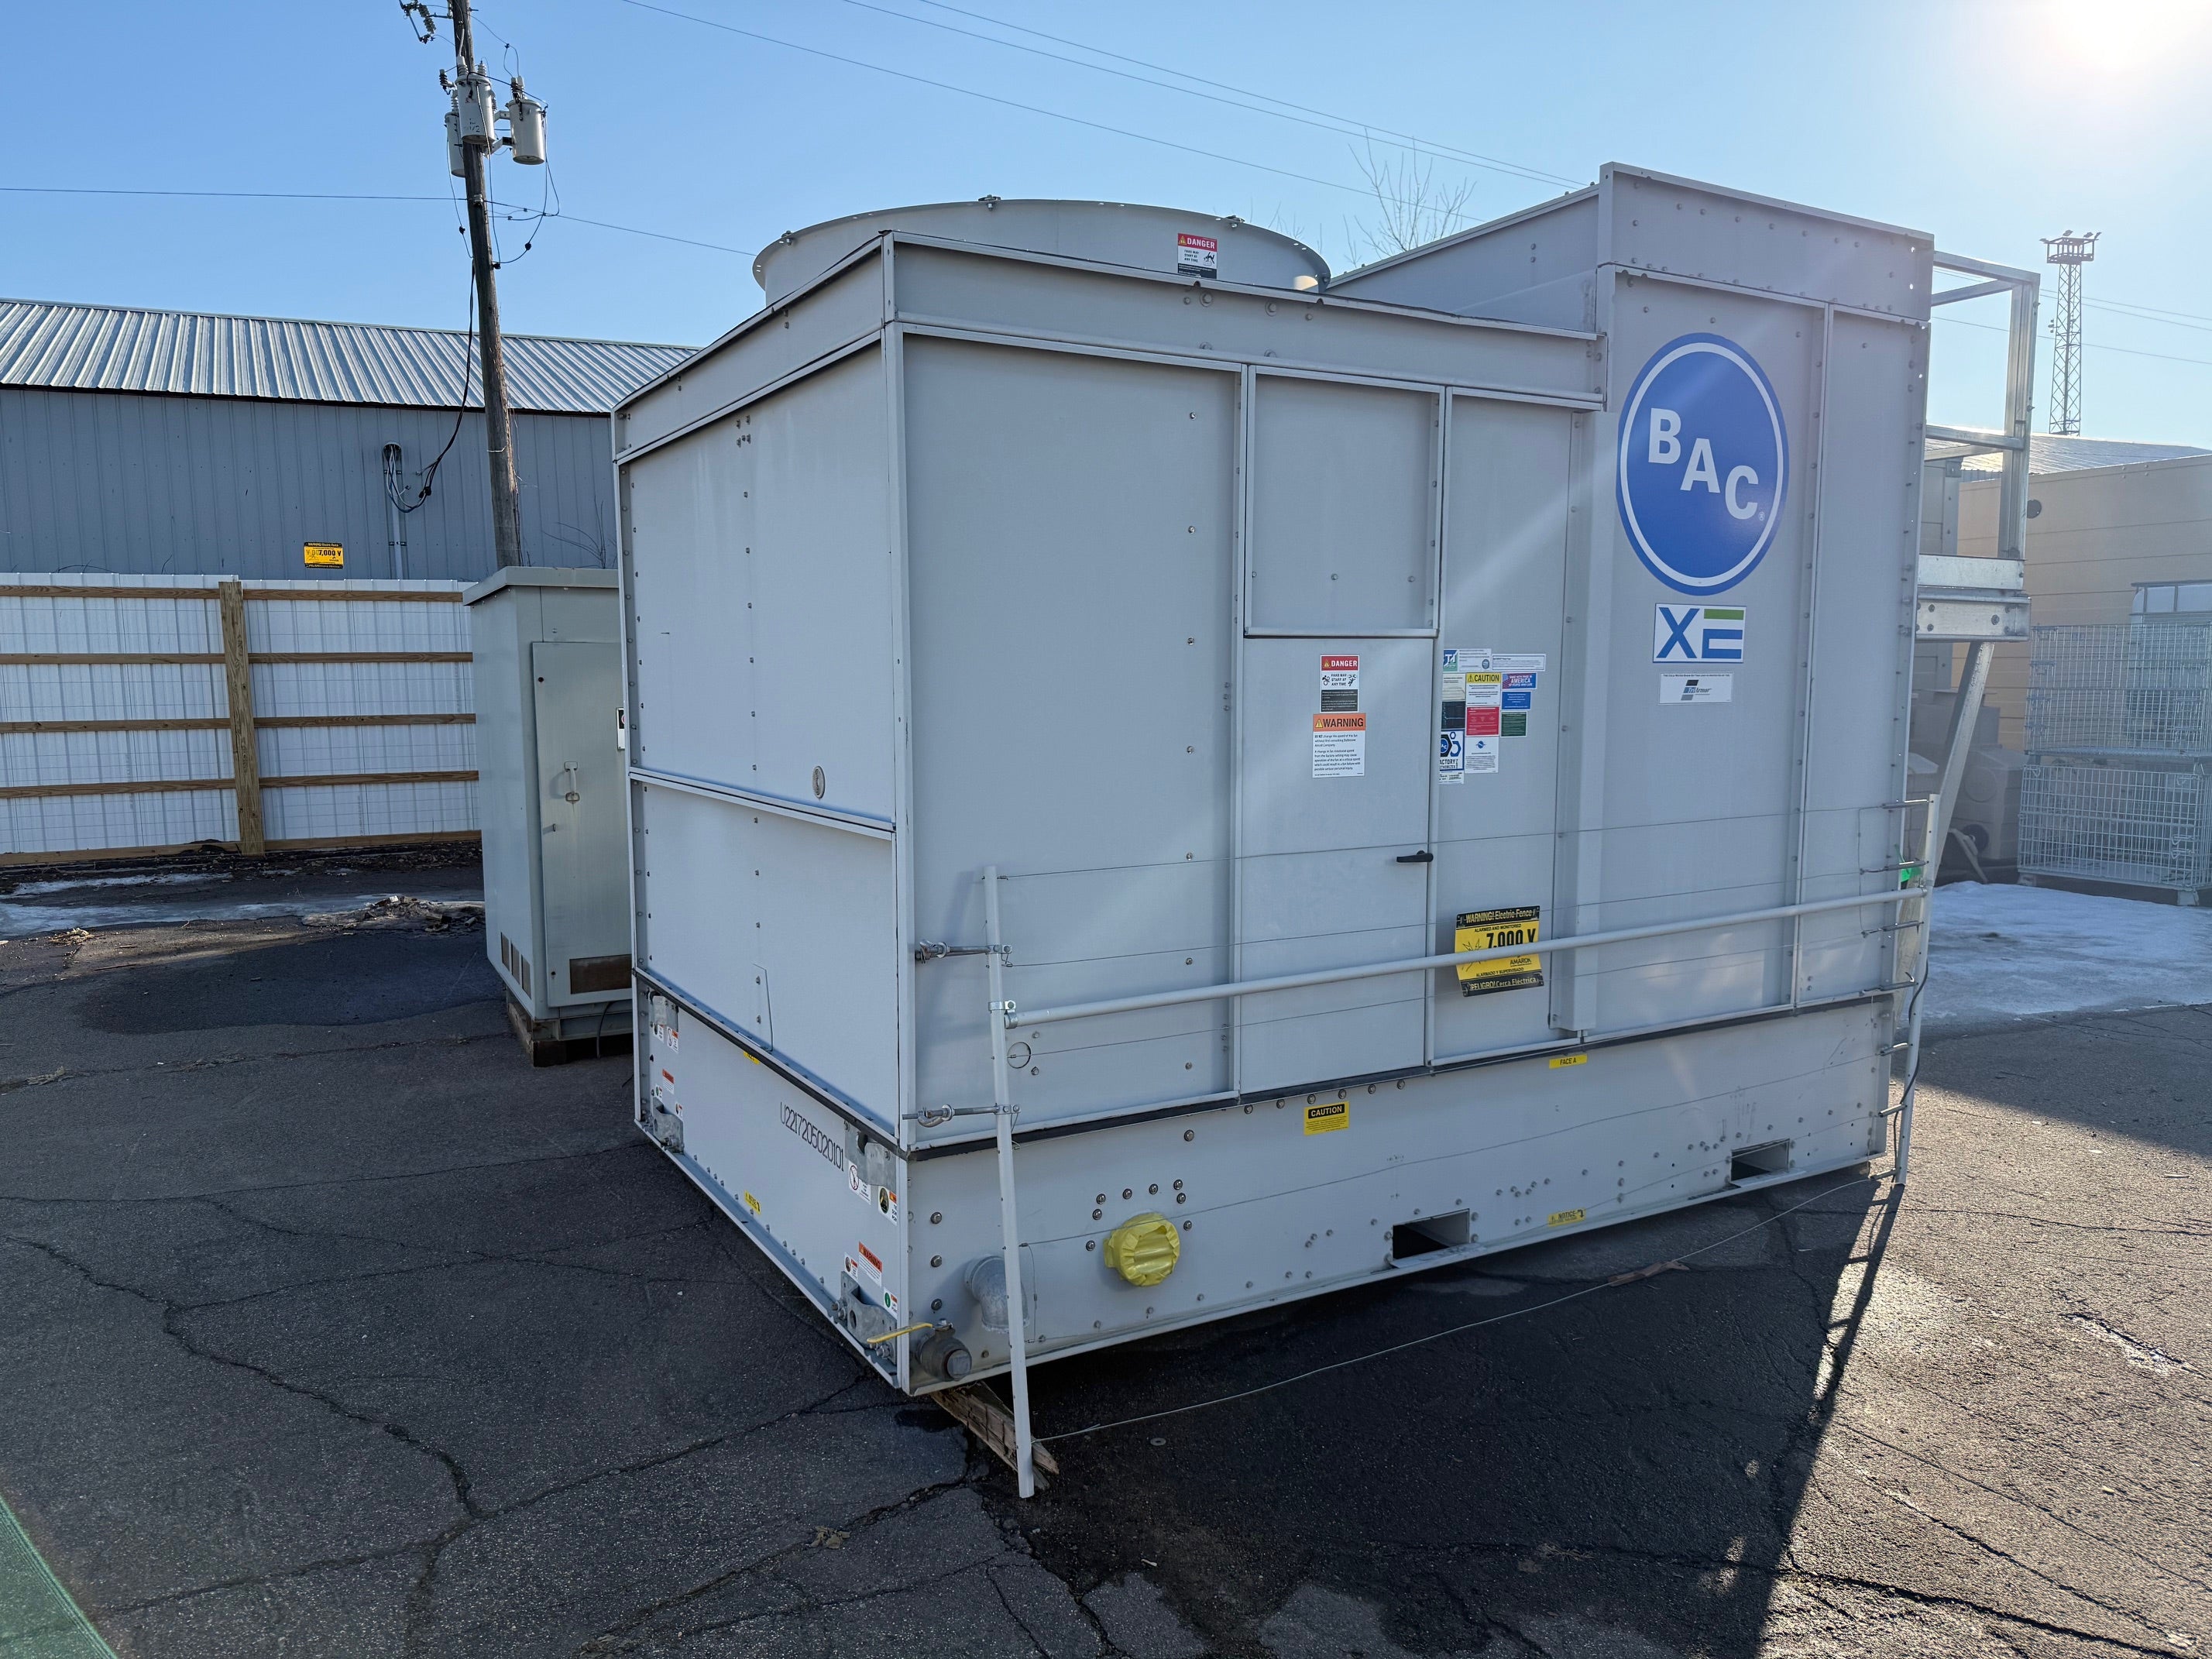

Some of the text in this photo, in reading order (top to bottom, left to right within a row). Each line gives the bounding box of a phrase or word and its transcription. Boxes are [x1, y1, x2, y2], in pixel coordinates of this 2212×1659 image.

[1187, 238, 1214, 249] DANGER
[1648, 407, 1759, 520] BAC
[1474, 674, 1499, 682] CAUTION
[1323, 718, 1363, 727] WARNING
[1466, 908, 1533, 923] WARNING! Electric Fence
[1527, 928, 1537, 943] V
[1560, 1057, 1572, 1066] FACE
[1310, 1105, 1342, 1117] CAUTION
[1558, 1210, 1575, 1219] NOTICE
[863, 1246, 881, 1271] WARNING
